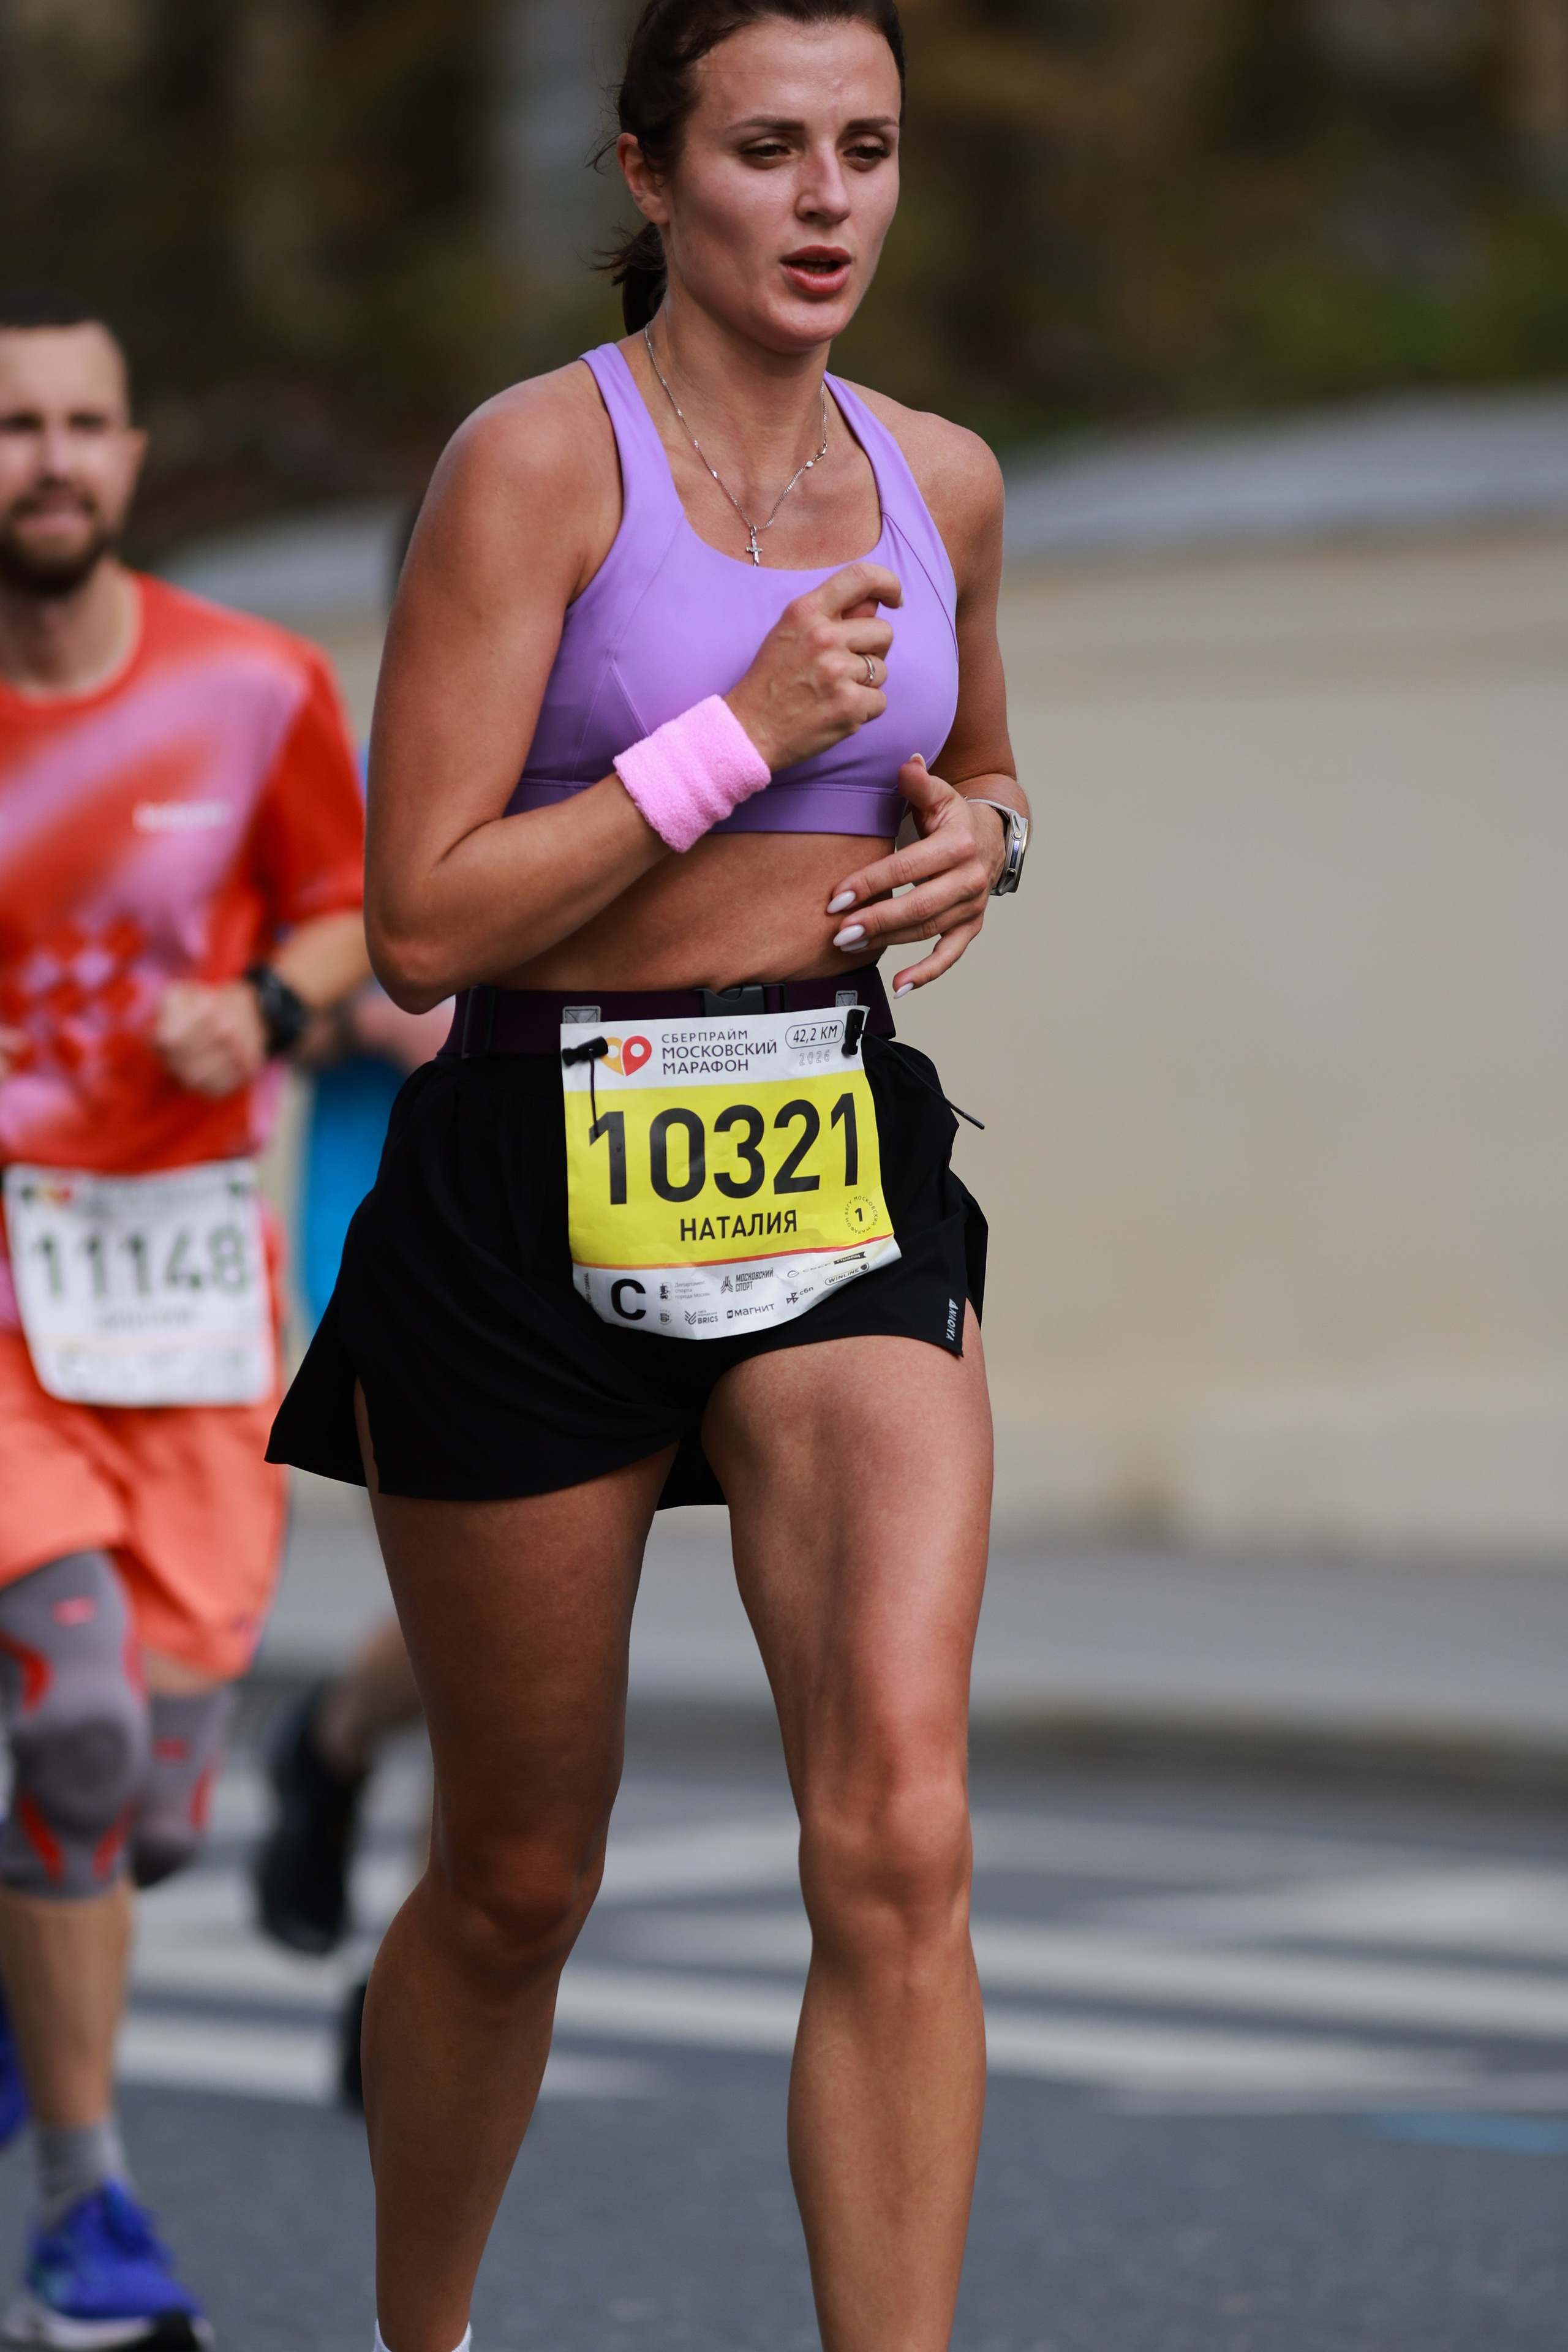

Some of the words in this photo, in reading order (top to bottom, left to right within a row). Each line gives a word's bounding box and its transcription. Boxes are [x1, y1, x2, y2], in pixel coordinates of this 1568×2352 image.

[662, 1028, 748, 1044] СБЕРПРАЙМ
[793, 1028, 816, 1044] 42,2
[821, 1025, 838, 1039] КМ
[662, 1039, 777, 1060] МОСКОВСКИЙ
[799, 1049, 831, 1066] 2026
[663, 1059, 748, 1075] МАРАФОН
[589, 1092, 859, 1205] 10321
[854, 1196, 878, 1226] МОСКОВСКИЙ
[854, 1207, 863, 1222] 1
[680, 1209, 797, 1242] НАТАЛИЯ
[845, 1218, 871, 1234] МАРАФОН
[34, 1224, 250, 1302] 11148
[735, 1267, 774, 1283] МОСКОВСКИЙ
[828, 1268, 859, 1283] WINLINE
[735, 1281, 753, 1292] СПОРТ
[611, 1278, 647, 1321] C
[698, 1316, 718, 1324] BRICS
